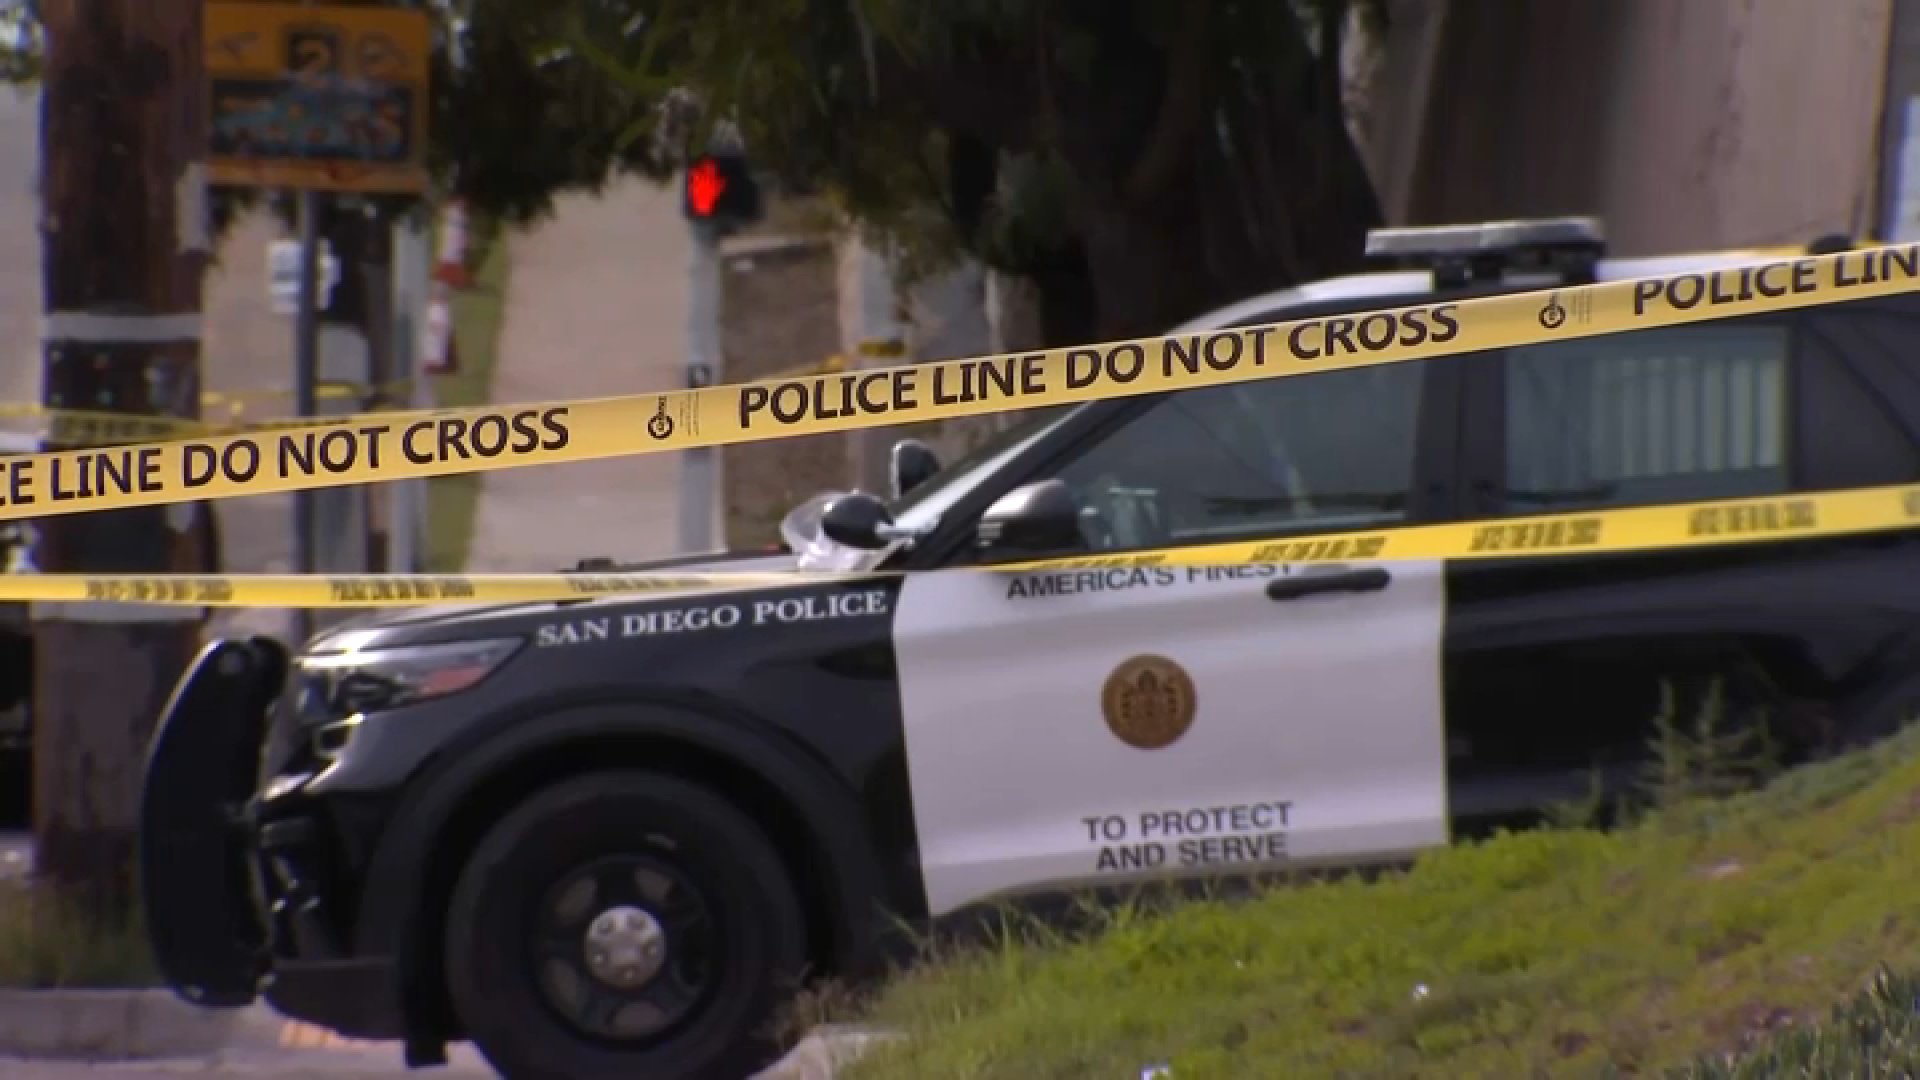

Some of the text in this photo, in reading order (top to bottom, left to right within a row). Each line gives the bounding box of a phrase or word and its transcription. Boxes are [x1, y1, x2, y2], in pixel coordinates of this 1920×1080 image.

[1634, 260, 1817, 315] POLICE
[739, 370, 917, 427] POLICE
[933, 354, 1045, 405] LINE
[1066, 343, 1145, 388] DO
[1162, 328, 1275, 377] NOT
[1287, 305, 1460, 361] CROSS
[51, 448, 163, 500] LINE
[183, 440, 260, 488] DO
[279, 426, 390, 478] NOT
[402, 408, 569, 464] CROSS
[1006, 565, 1175, 600] AMERICA'S
[536, 590, 887, 648] SAN DIEGO POLICE
[1081, 801, 1292, 841] TO PROTECT
[1097, 832, 1287, 870] AND SERVE
